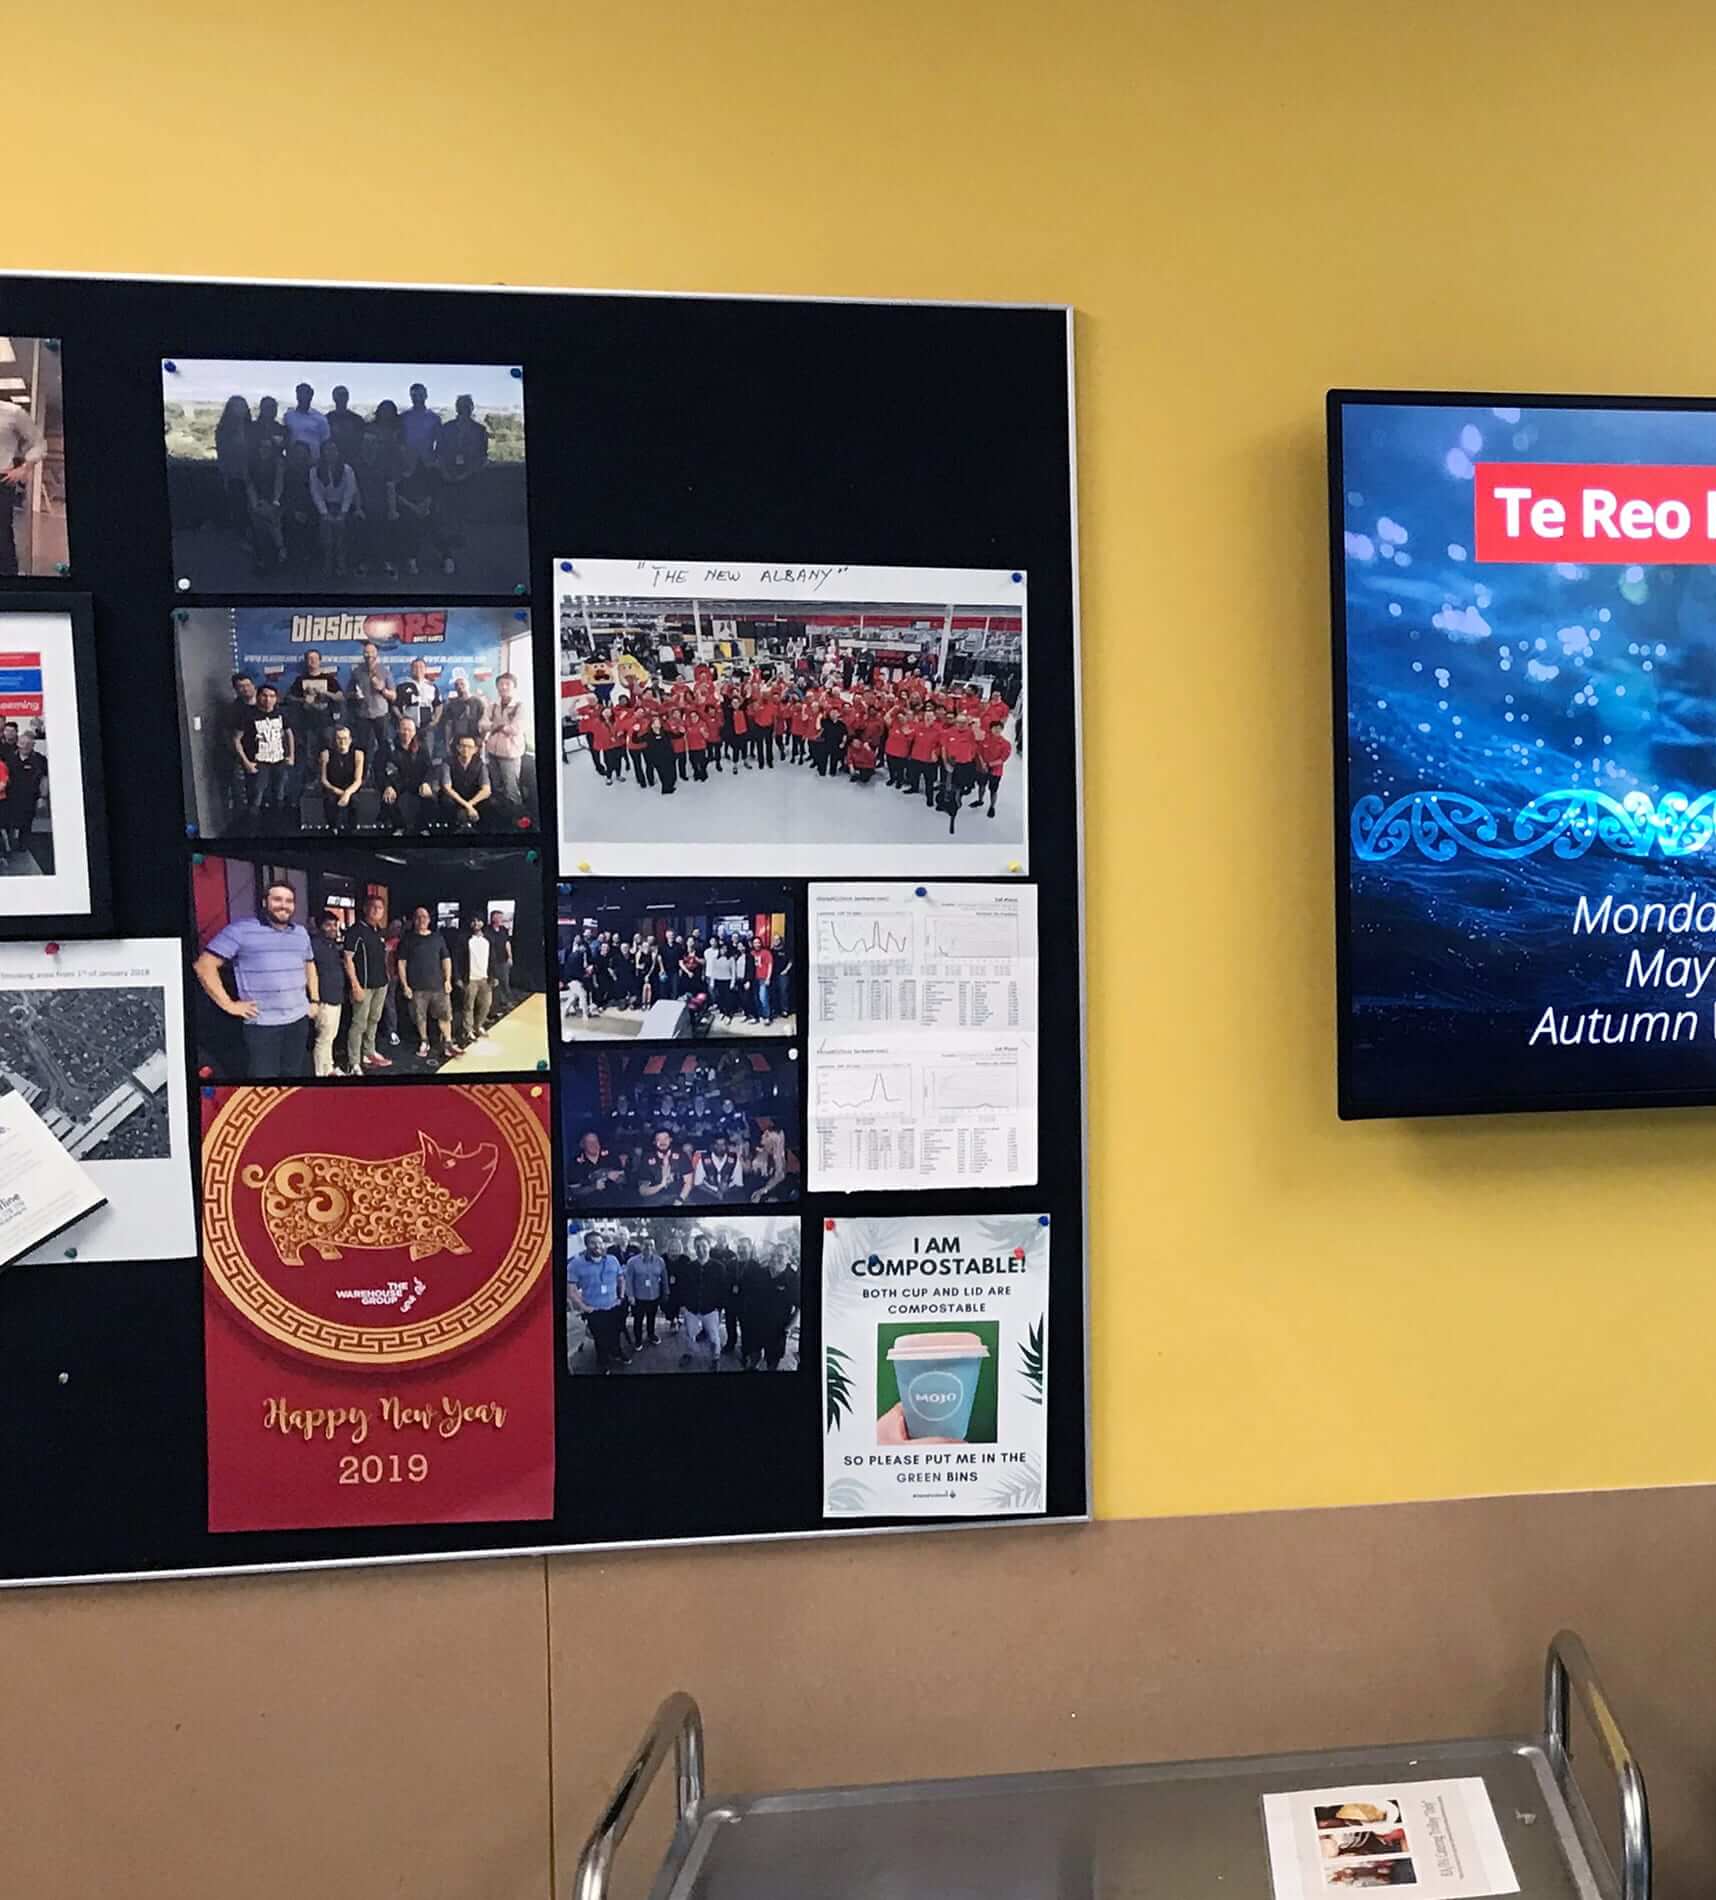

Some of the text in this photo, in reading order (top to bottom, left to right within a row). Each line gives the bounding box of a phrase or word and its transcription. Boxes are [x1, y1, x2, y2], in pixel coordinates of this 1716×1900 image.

[1492, 486, 1567, 539] Te
[1581, 487, 1692, 540] Reo
[704, 567, 741, 583] NEW
[1527, 1006, 1699, 1045] Autumn
[913, 1236, 962, 1254] I AM
[851, 1255, 1027, 1277] COMPOSTABLE!
[387, 1281, 409, 1291] THE
[861, 1285, 1012, 1298] BOTH CUP AND LID ARE
[335, 1289, 403, 1299] WAREHOUSE
[361, 1296, 399, 1305] GROUP
[887, 1302, 985, 1314] COMPOSTABLE
[915, 1391, 957, 1404] MOJO
[263, 1395, 508, 1444] Happy New Year
[843, 1451, 1026, 1466] SO PLEASE PUT ME IN THE
[338, 1453, 430, 1487] 2019
[895, 1471, 978, 1483] GREEN BINS
